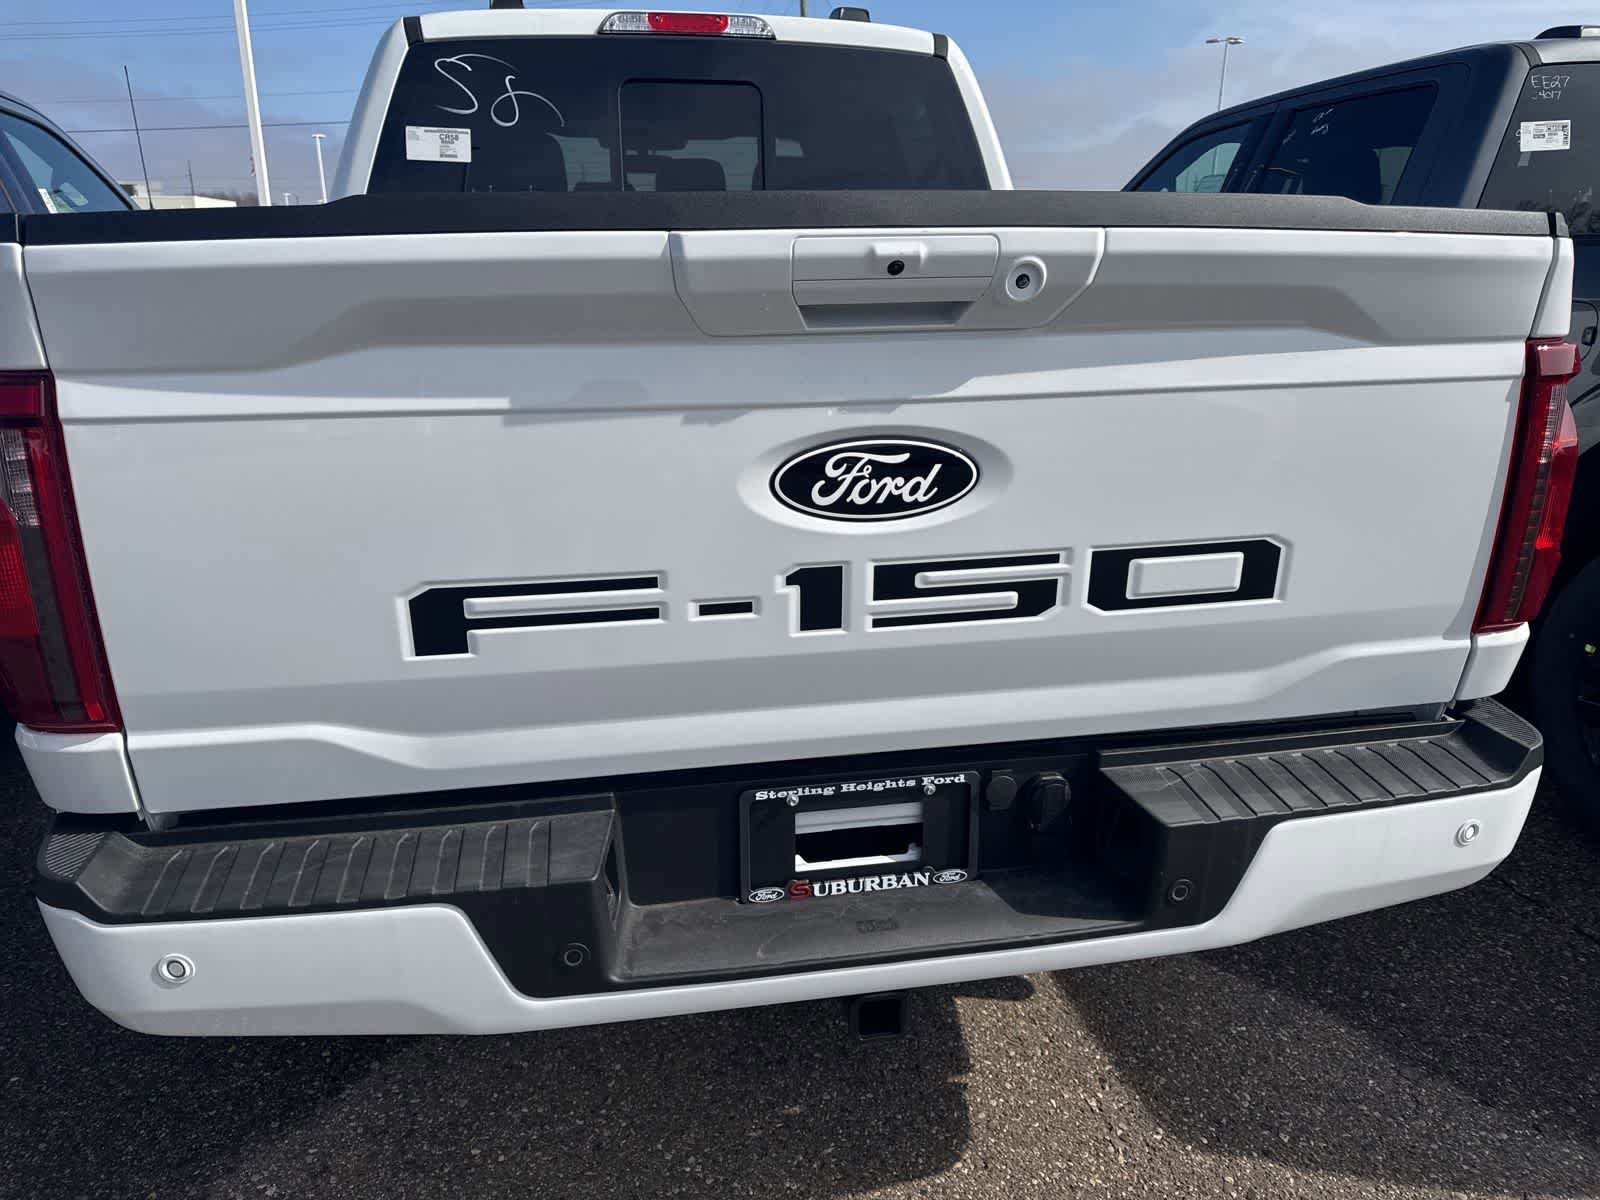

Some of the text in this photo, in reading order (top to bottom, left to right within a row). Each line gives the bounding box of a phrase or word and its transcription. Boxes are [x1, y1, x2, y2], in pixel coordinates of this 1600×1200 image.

[811, 451, 943, 507] Ford
[406, 536, 1284, 659] F-150
[755, 774, 966, 800] Sterling Heights Ford
[789, 871, 930, 901] SUBURBAN
